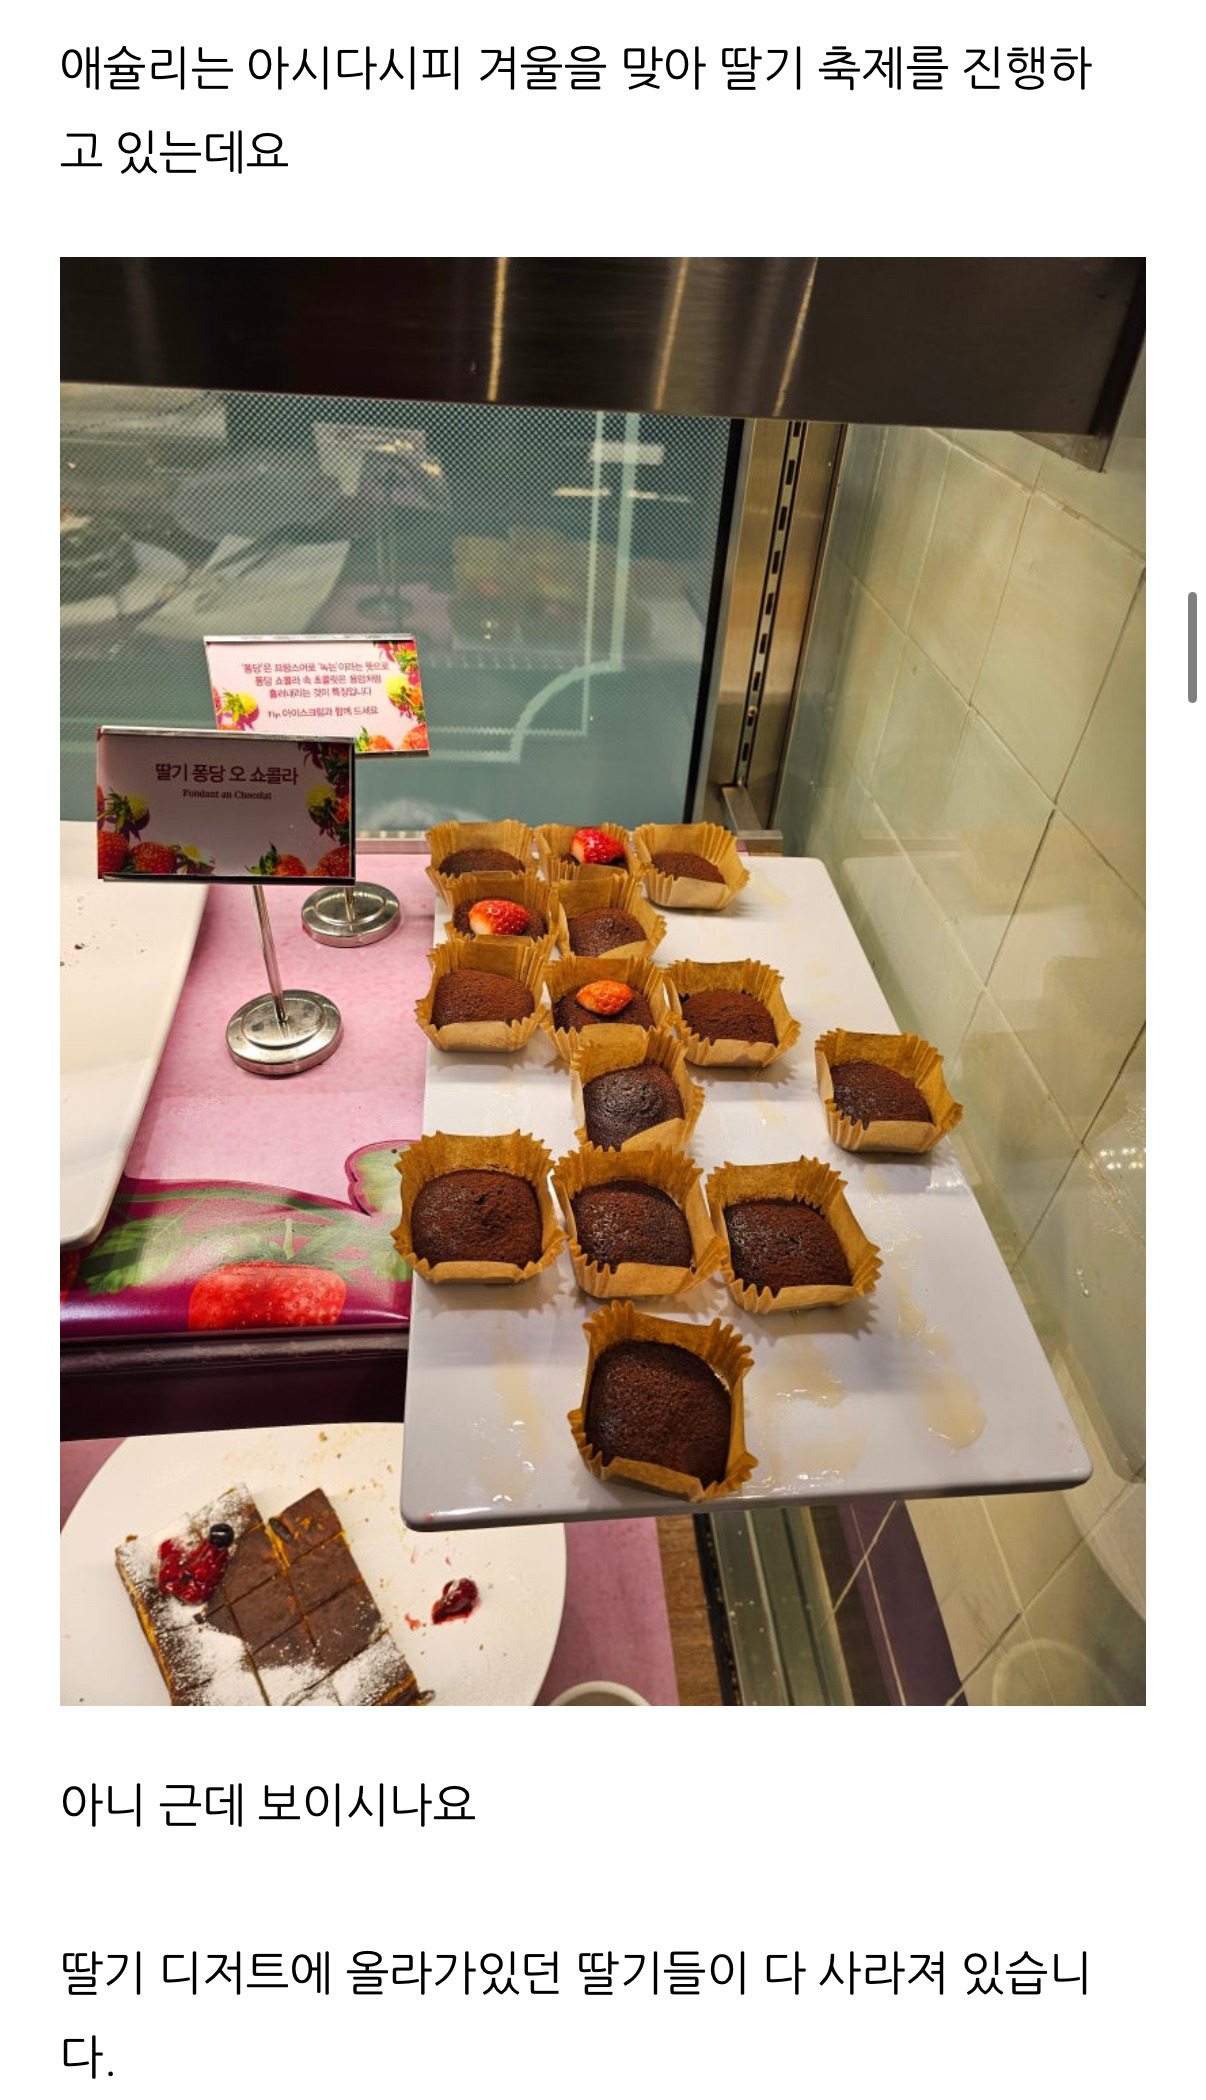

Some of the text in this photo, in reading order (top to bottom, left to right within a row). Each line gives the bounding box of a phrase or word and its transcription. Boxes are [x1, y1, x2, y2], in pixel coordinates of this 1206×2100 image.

[274, 662, 317, 673] 프랑스어로
[365, 661, 389, 672] 뜻으로
[302, 675, 312, 685] 속
[313, 687, 330, 698] 것이
[282, 706, 333, 718] 아이스크림과
[335, 706, 352, 717] 함께
[353, 705, 379, 716] 드세요
[155, 763, 299, 785] 딸기 퐁당 오 쇼콜라
[182, 789, 272, 800] Fondant au Chocolat
